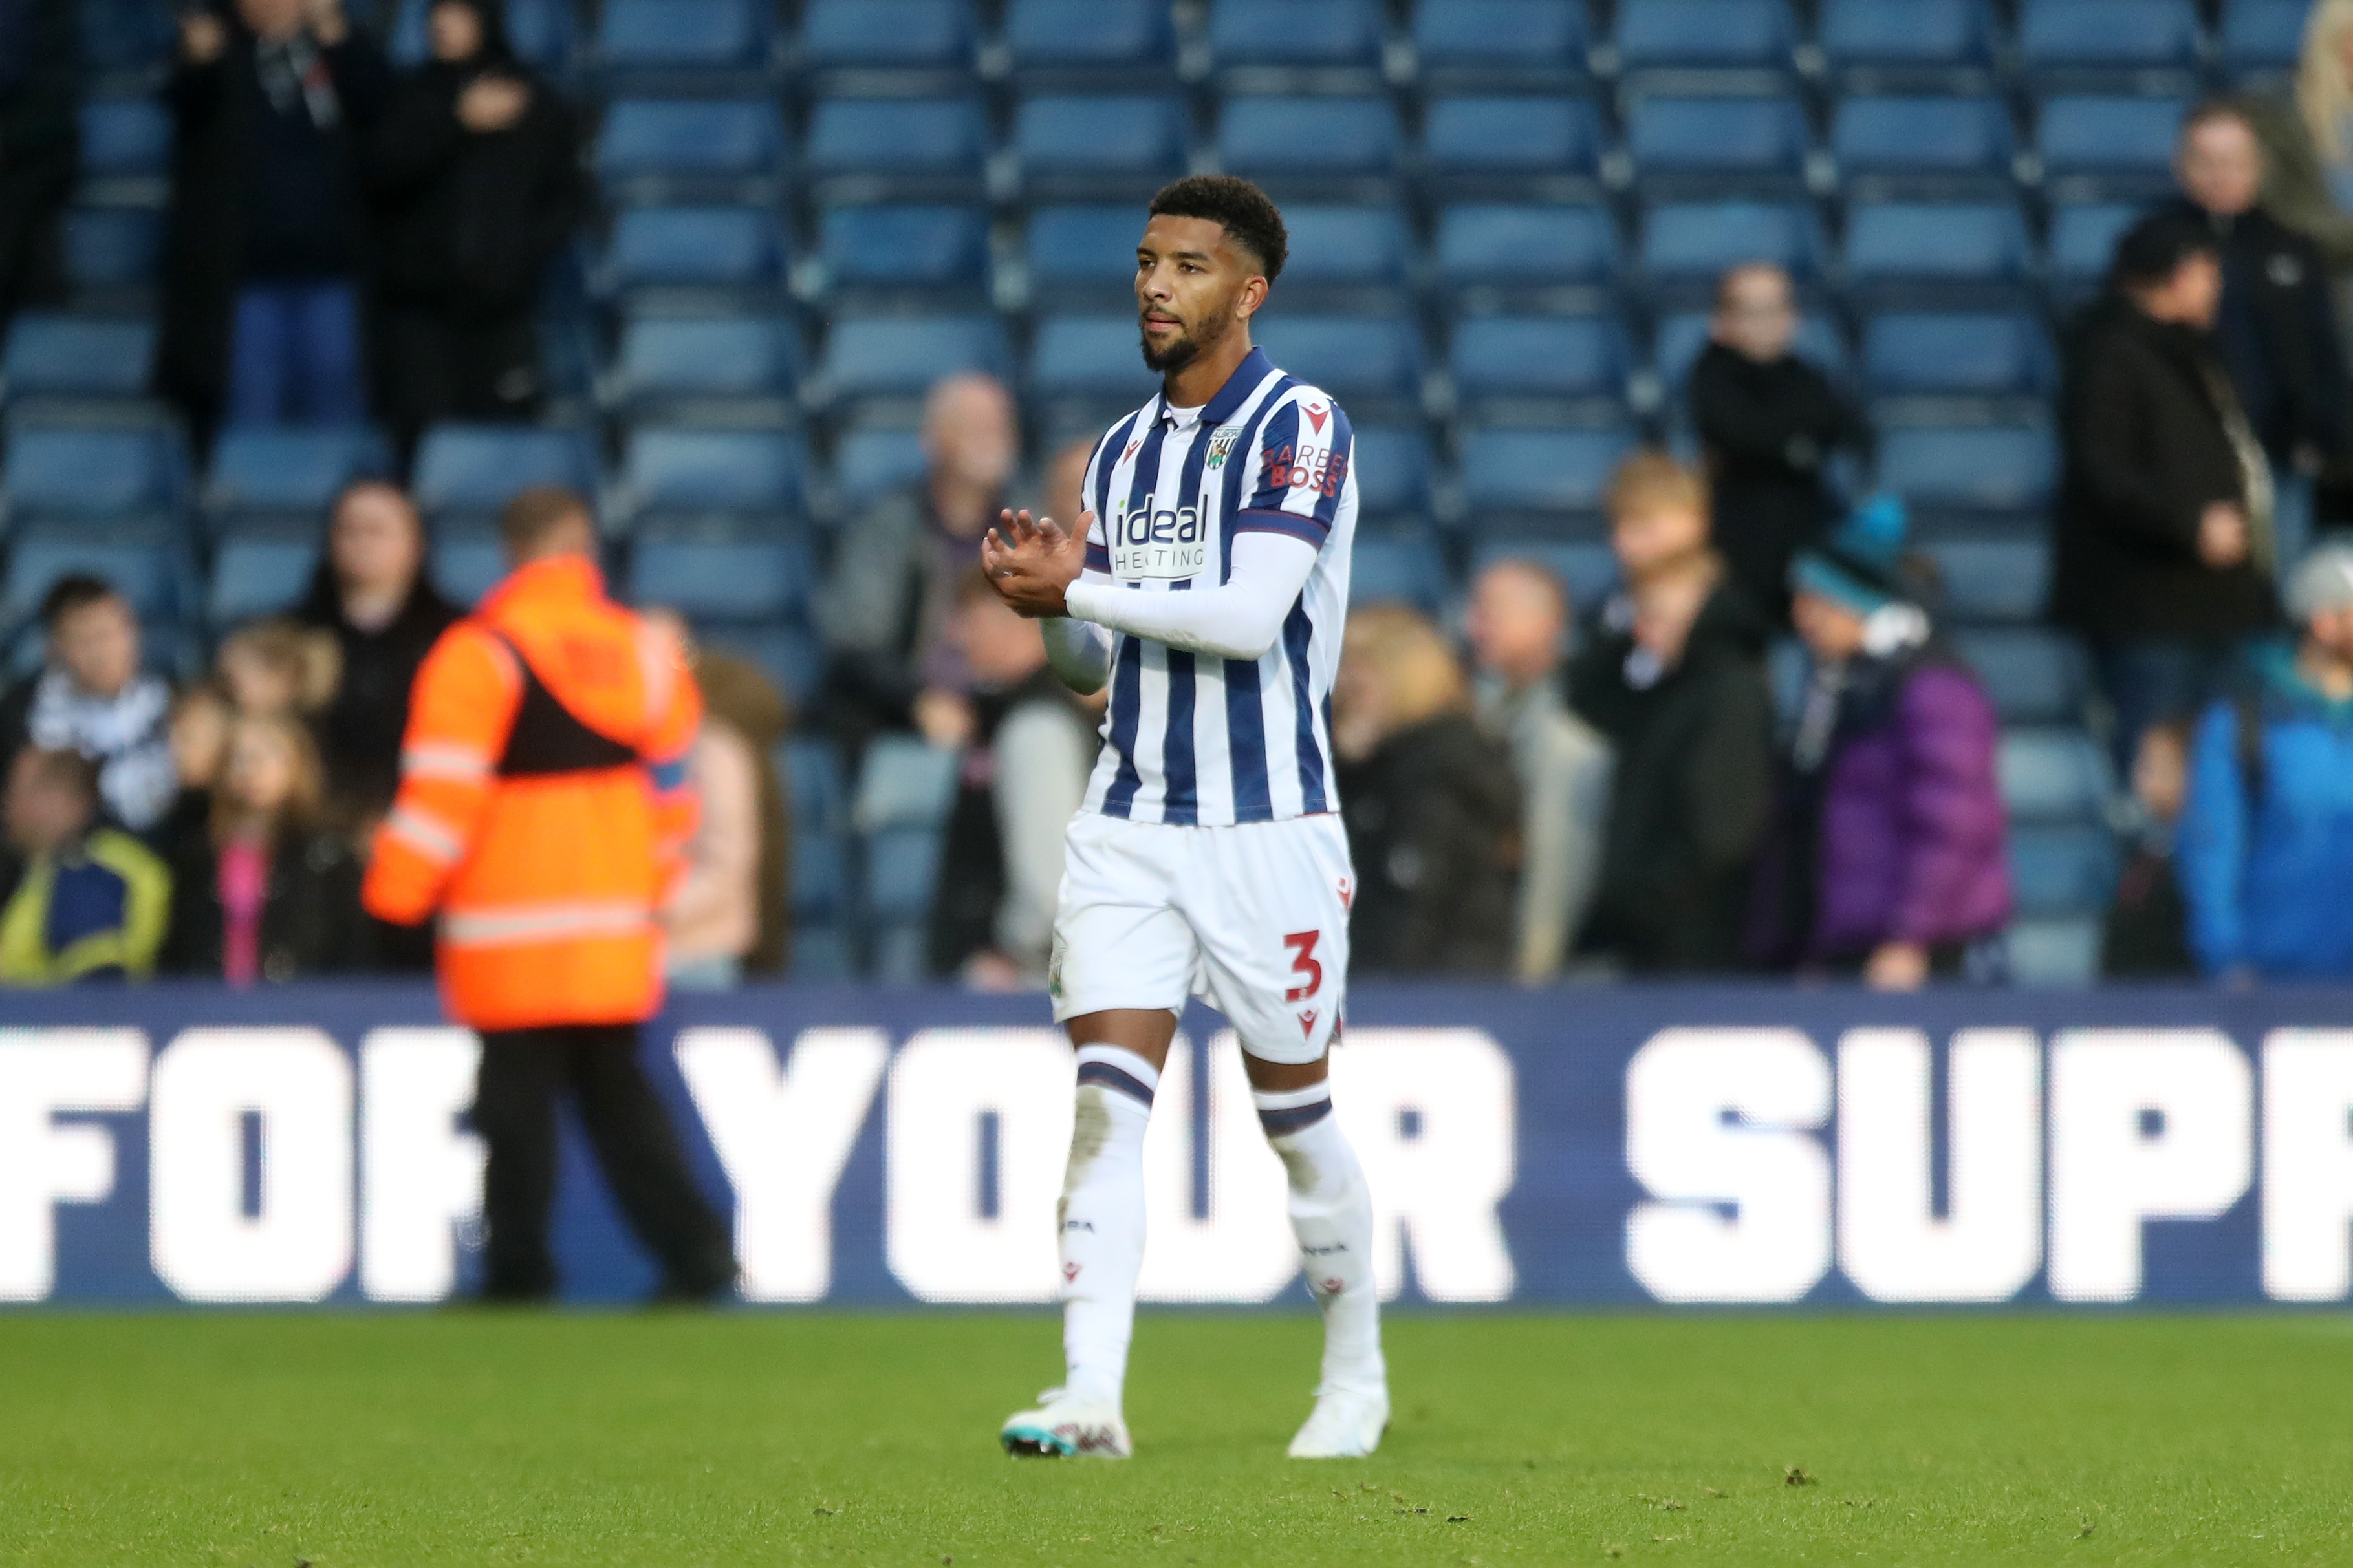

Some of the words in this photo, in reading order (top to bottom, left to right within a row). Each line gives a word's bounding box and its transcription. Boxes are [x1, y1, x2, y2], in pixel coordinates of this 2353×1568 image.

[1270, 465, 1338, 498] BOSS
[1116, 493, 1208, 548] ideal
[1284, 929, 1322, 1003] 3
[671, 1026, 1518, 1302] YOUR
